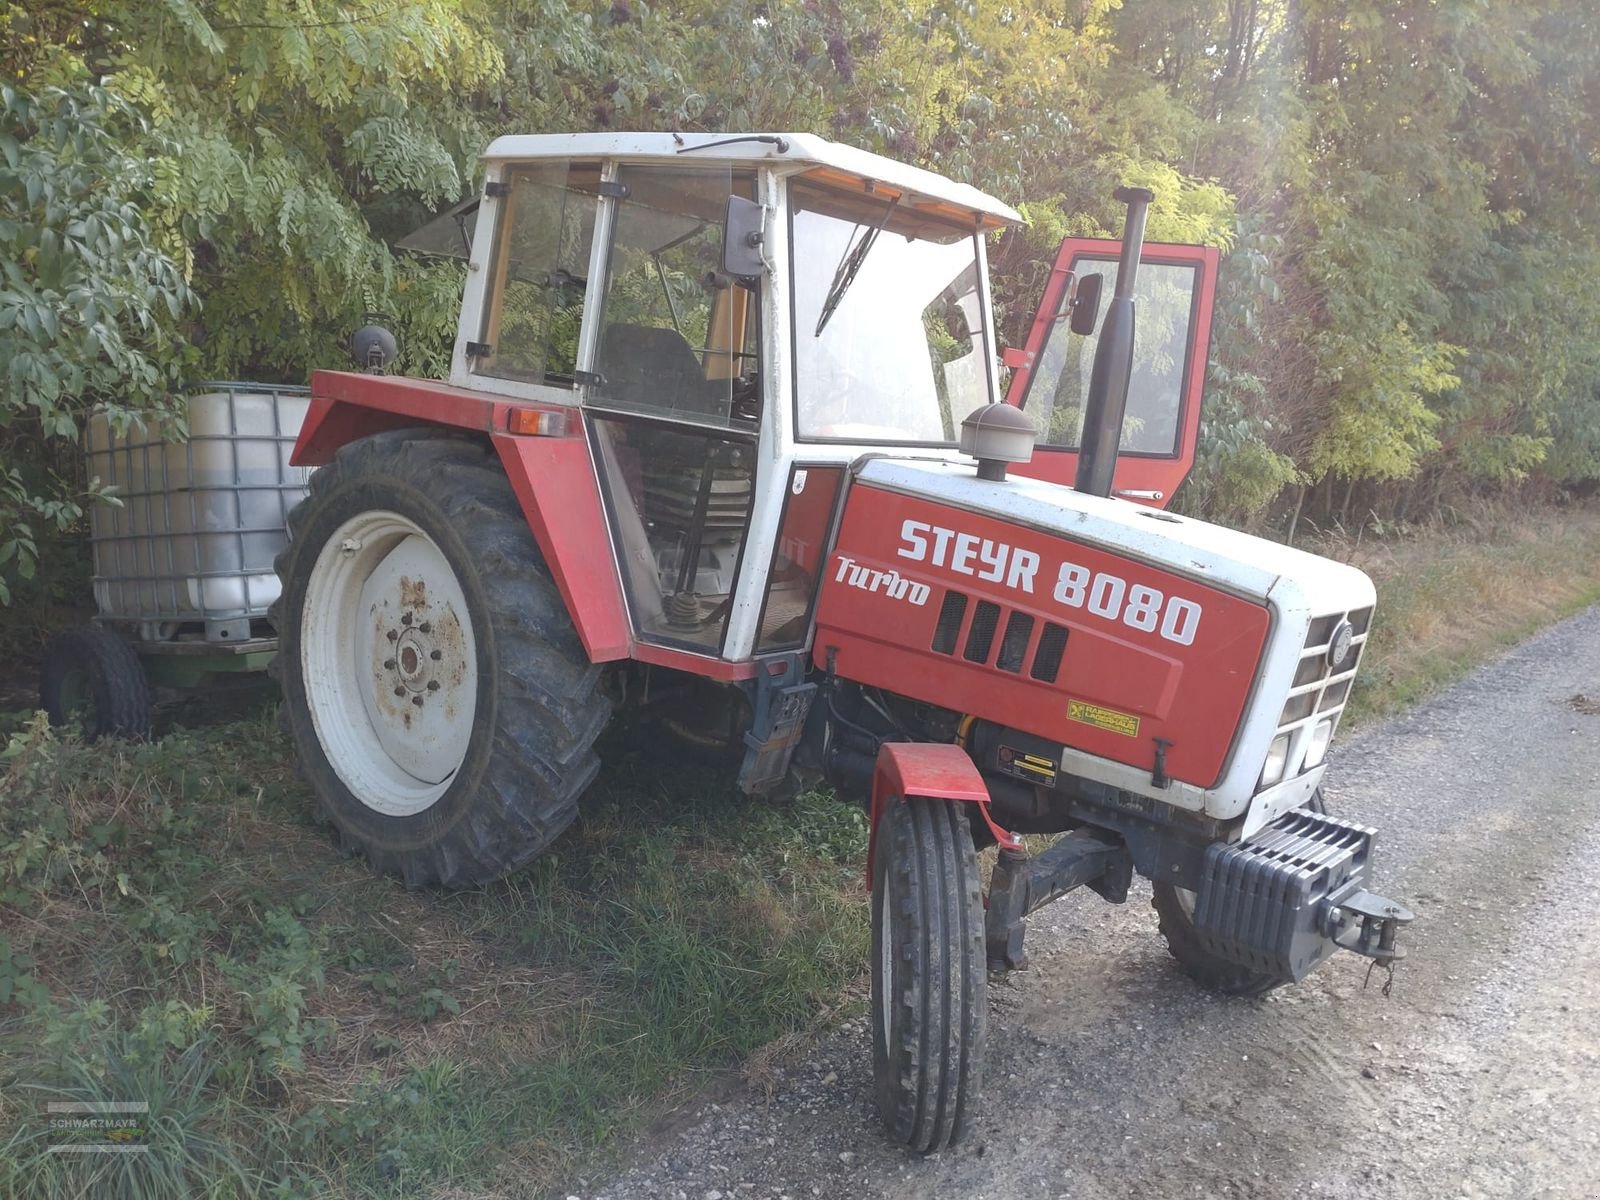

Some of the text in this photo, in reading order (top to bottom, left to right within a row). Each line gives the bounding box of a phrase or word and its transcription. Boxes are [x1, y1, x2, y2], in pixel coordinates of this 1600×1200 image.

[833, 556, 931, 607] Turbo
[897, 519, 1202, 646] STEYR 8080
